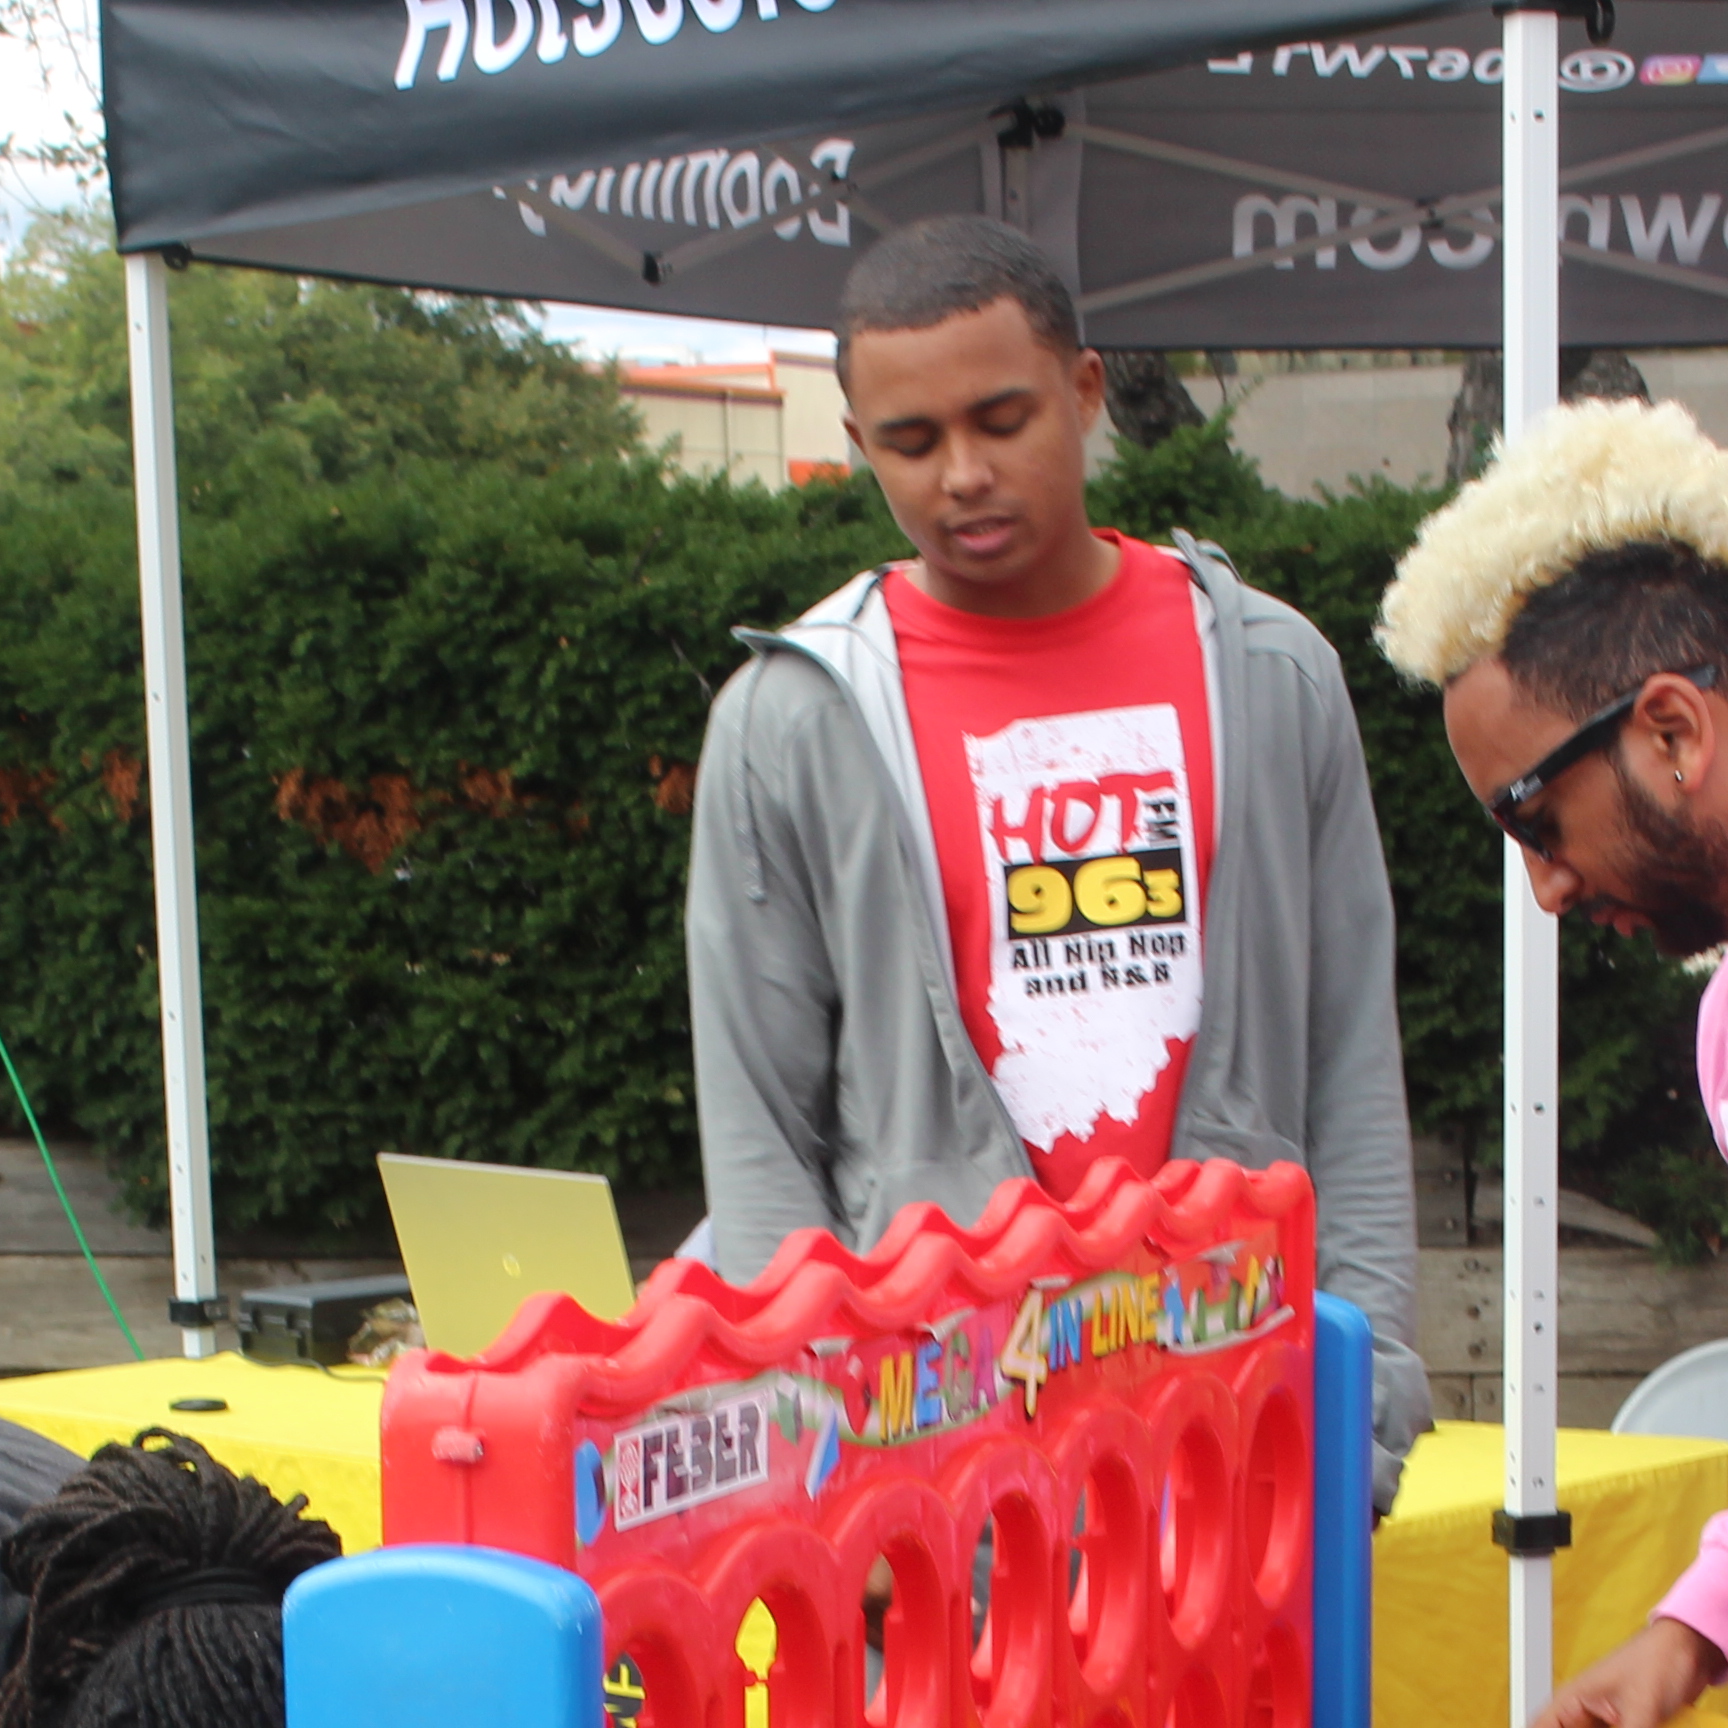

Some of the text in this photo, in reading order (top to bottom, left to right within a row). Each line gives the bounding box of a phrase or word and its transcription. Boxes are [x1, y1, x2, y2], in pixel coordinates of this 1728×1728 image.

[989, 771, 1176, 865] HOT
[1013, 937, 1051, 969] All
[641, 1271, 1160, 1510] FEBER MEGA 4 IN LINE
